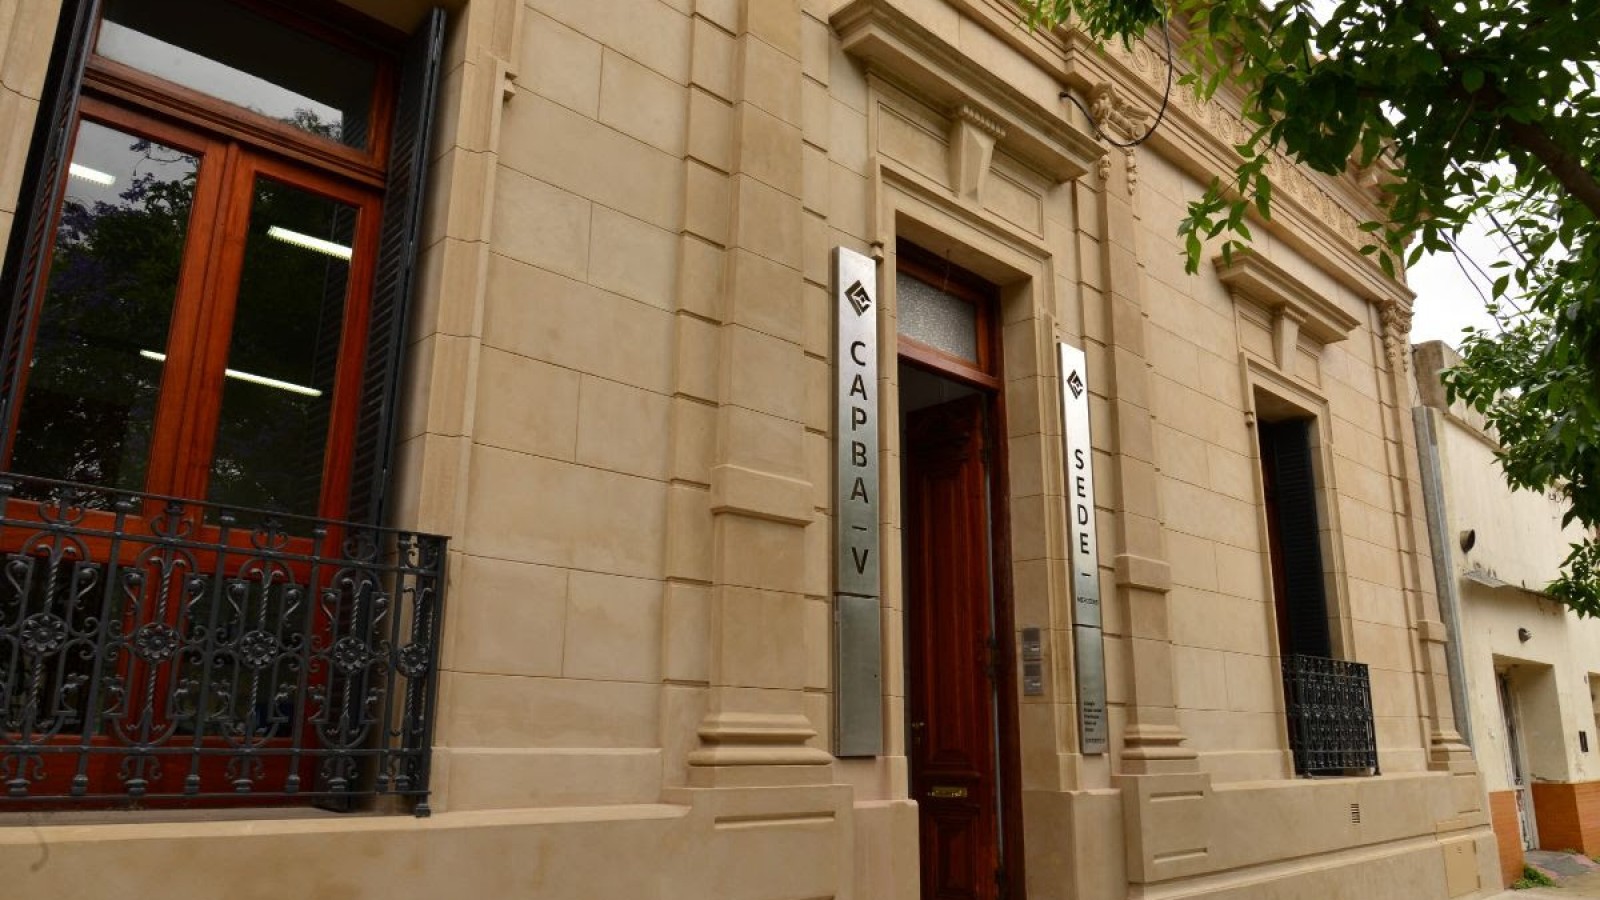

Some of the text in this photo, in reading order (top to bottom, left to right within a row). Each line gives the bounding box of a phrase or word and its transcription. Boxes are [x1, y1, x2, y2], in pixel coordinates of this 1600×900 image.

[850, 340, 868, 504] CAPBA
[1074, 448, 1090, 555] SEDE
[851, 546, 869, 575] V
